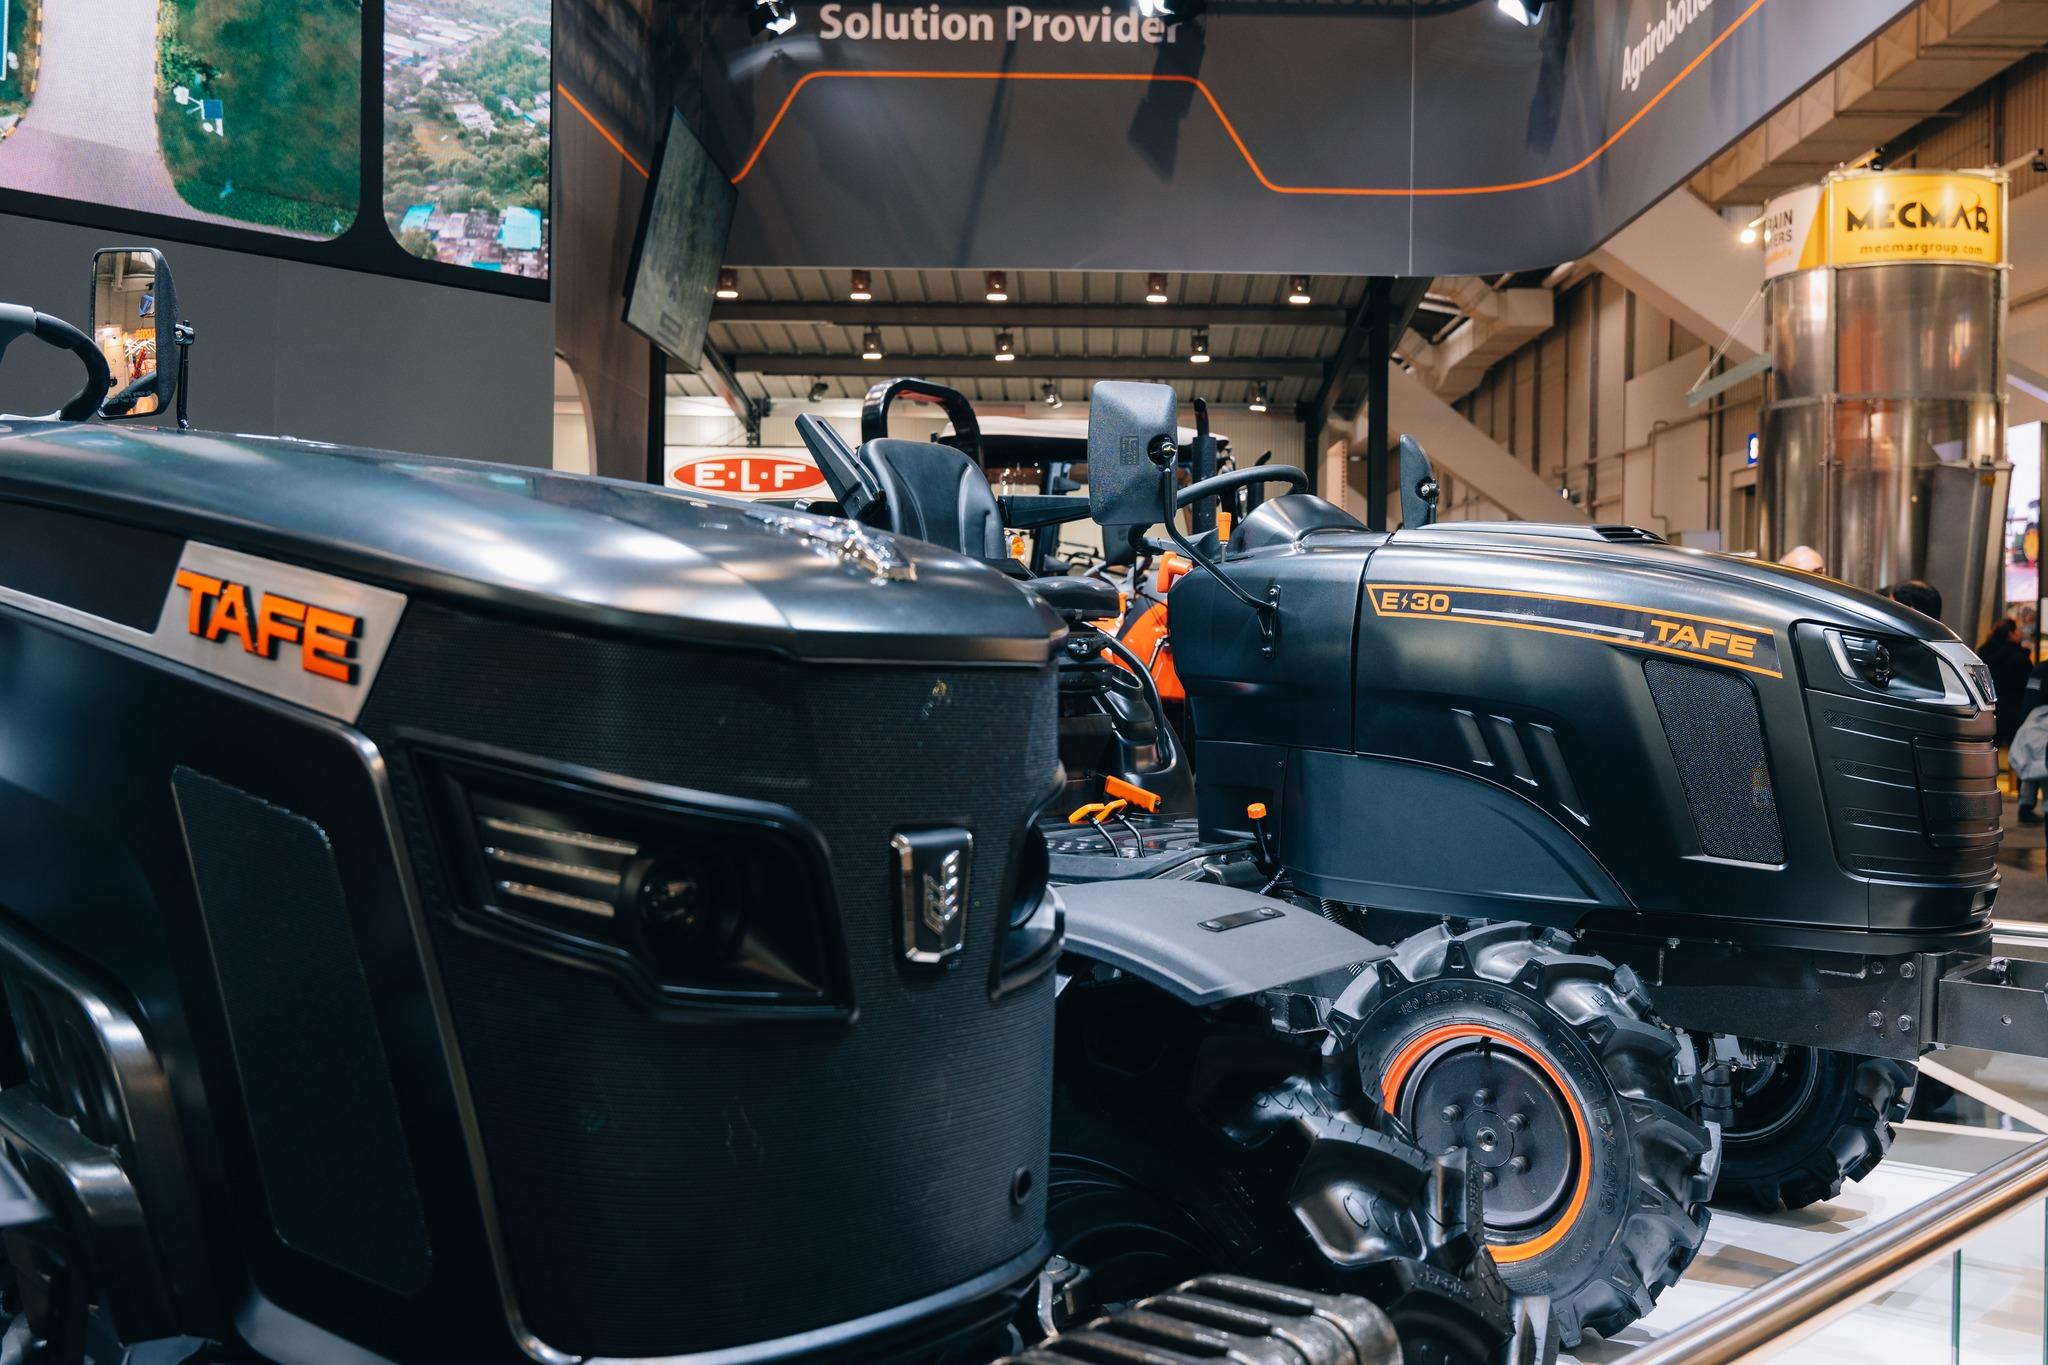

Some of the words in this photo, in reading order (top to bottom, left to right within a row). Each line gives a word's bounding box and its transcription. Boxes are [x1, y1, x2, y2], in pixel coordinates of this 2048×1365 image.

[819, 3, 994, 41] Solution
[1006, 6, 1183, 43] Provider
[1846, 201, 1989, 234] MECMAR
[1860, 243, 1983, 256] mecmargroup.com
[176, 568, 361, 685] TAFE
[1650, 620, 1759, 659] TAFE
